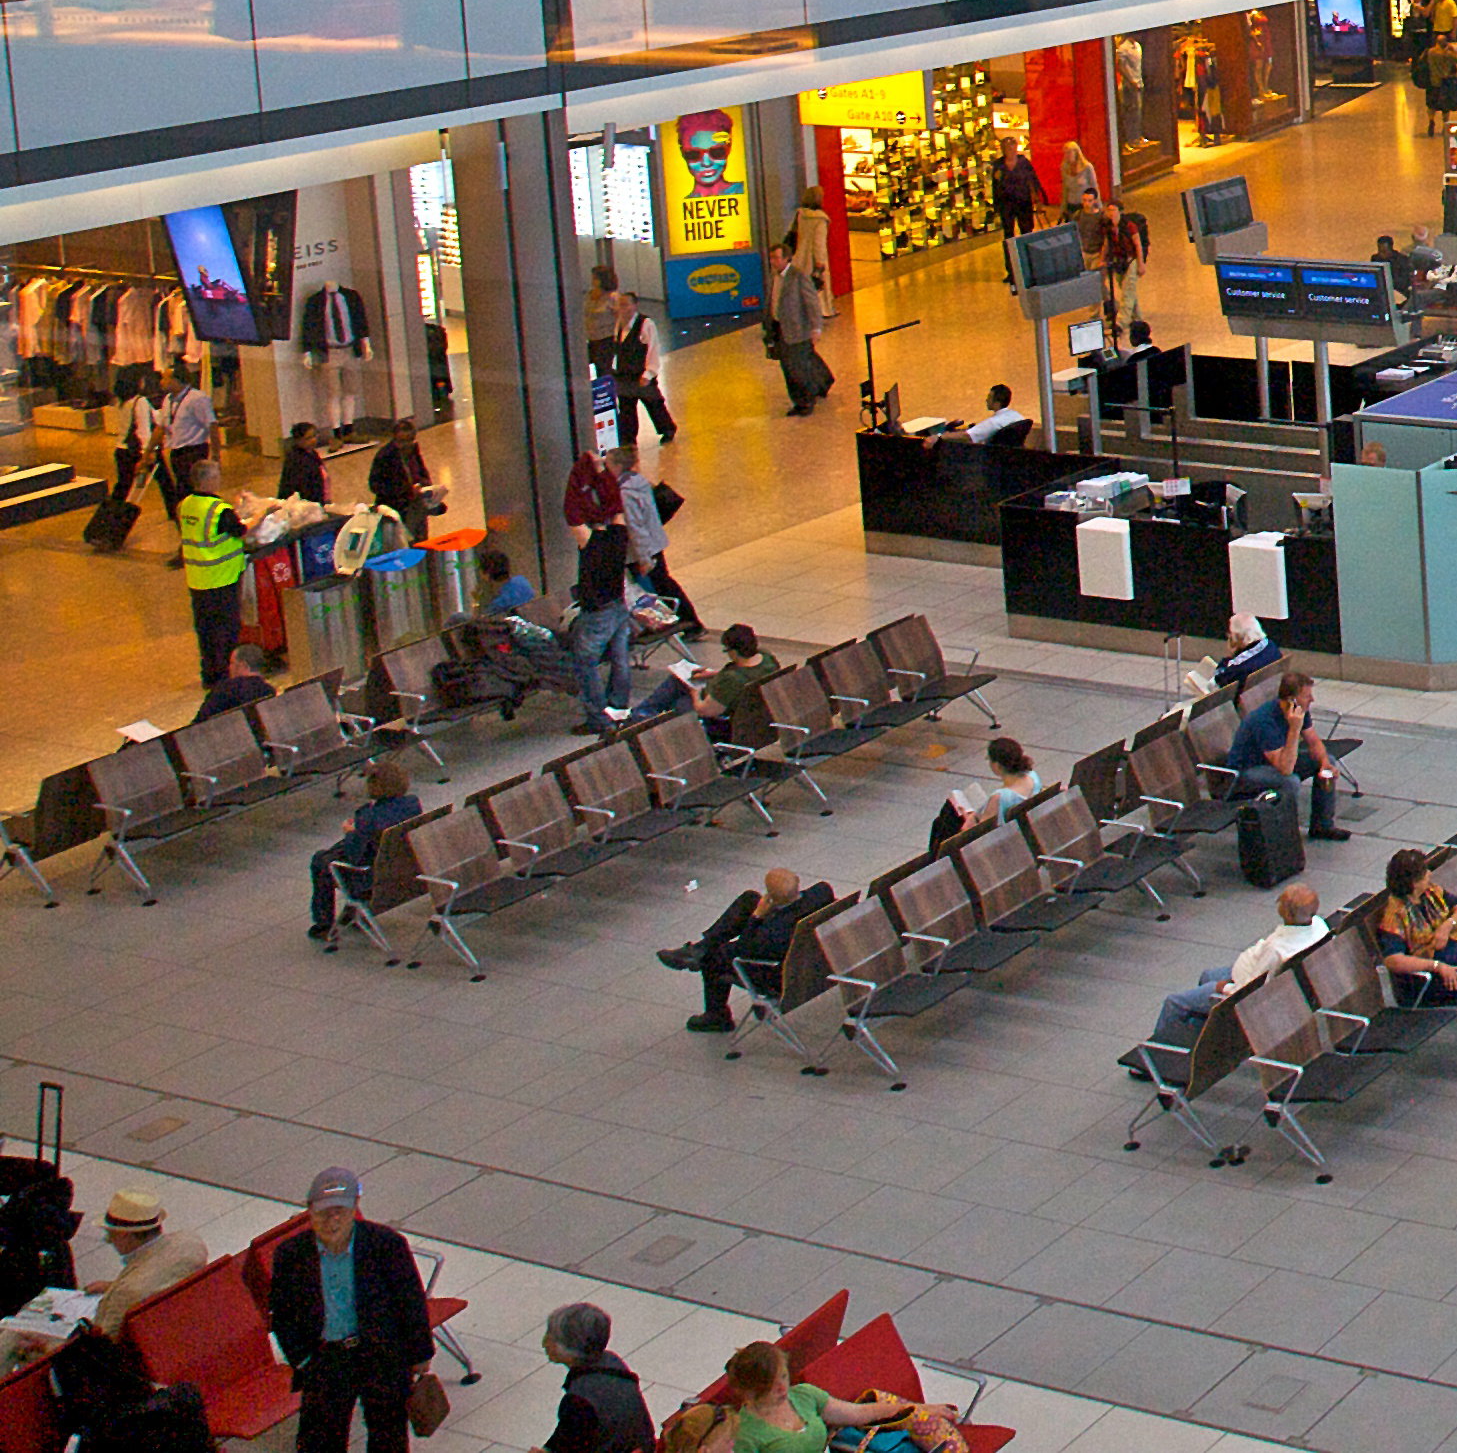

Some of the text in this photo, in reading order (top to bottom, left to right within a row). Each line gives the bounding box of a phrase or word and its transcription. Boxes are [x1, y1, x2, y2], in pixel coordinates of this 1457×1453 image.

[847, 108, 871, 121] Gate
[682, 197, 739, 220] NEVER
[684, 220, 726, 241] HIDE
[294, 239, 338, 259] EISS
[1226, 288, 1286, 299] Customer service
[1308, 293, 1370, 305] Customer service
